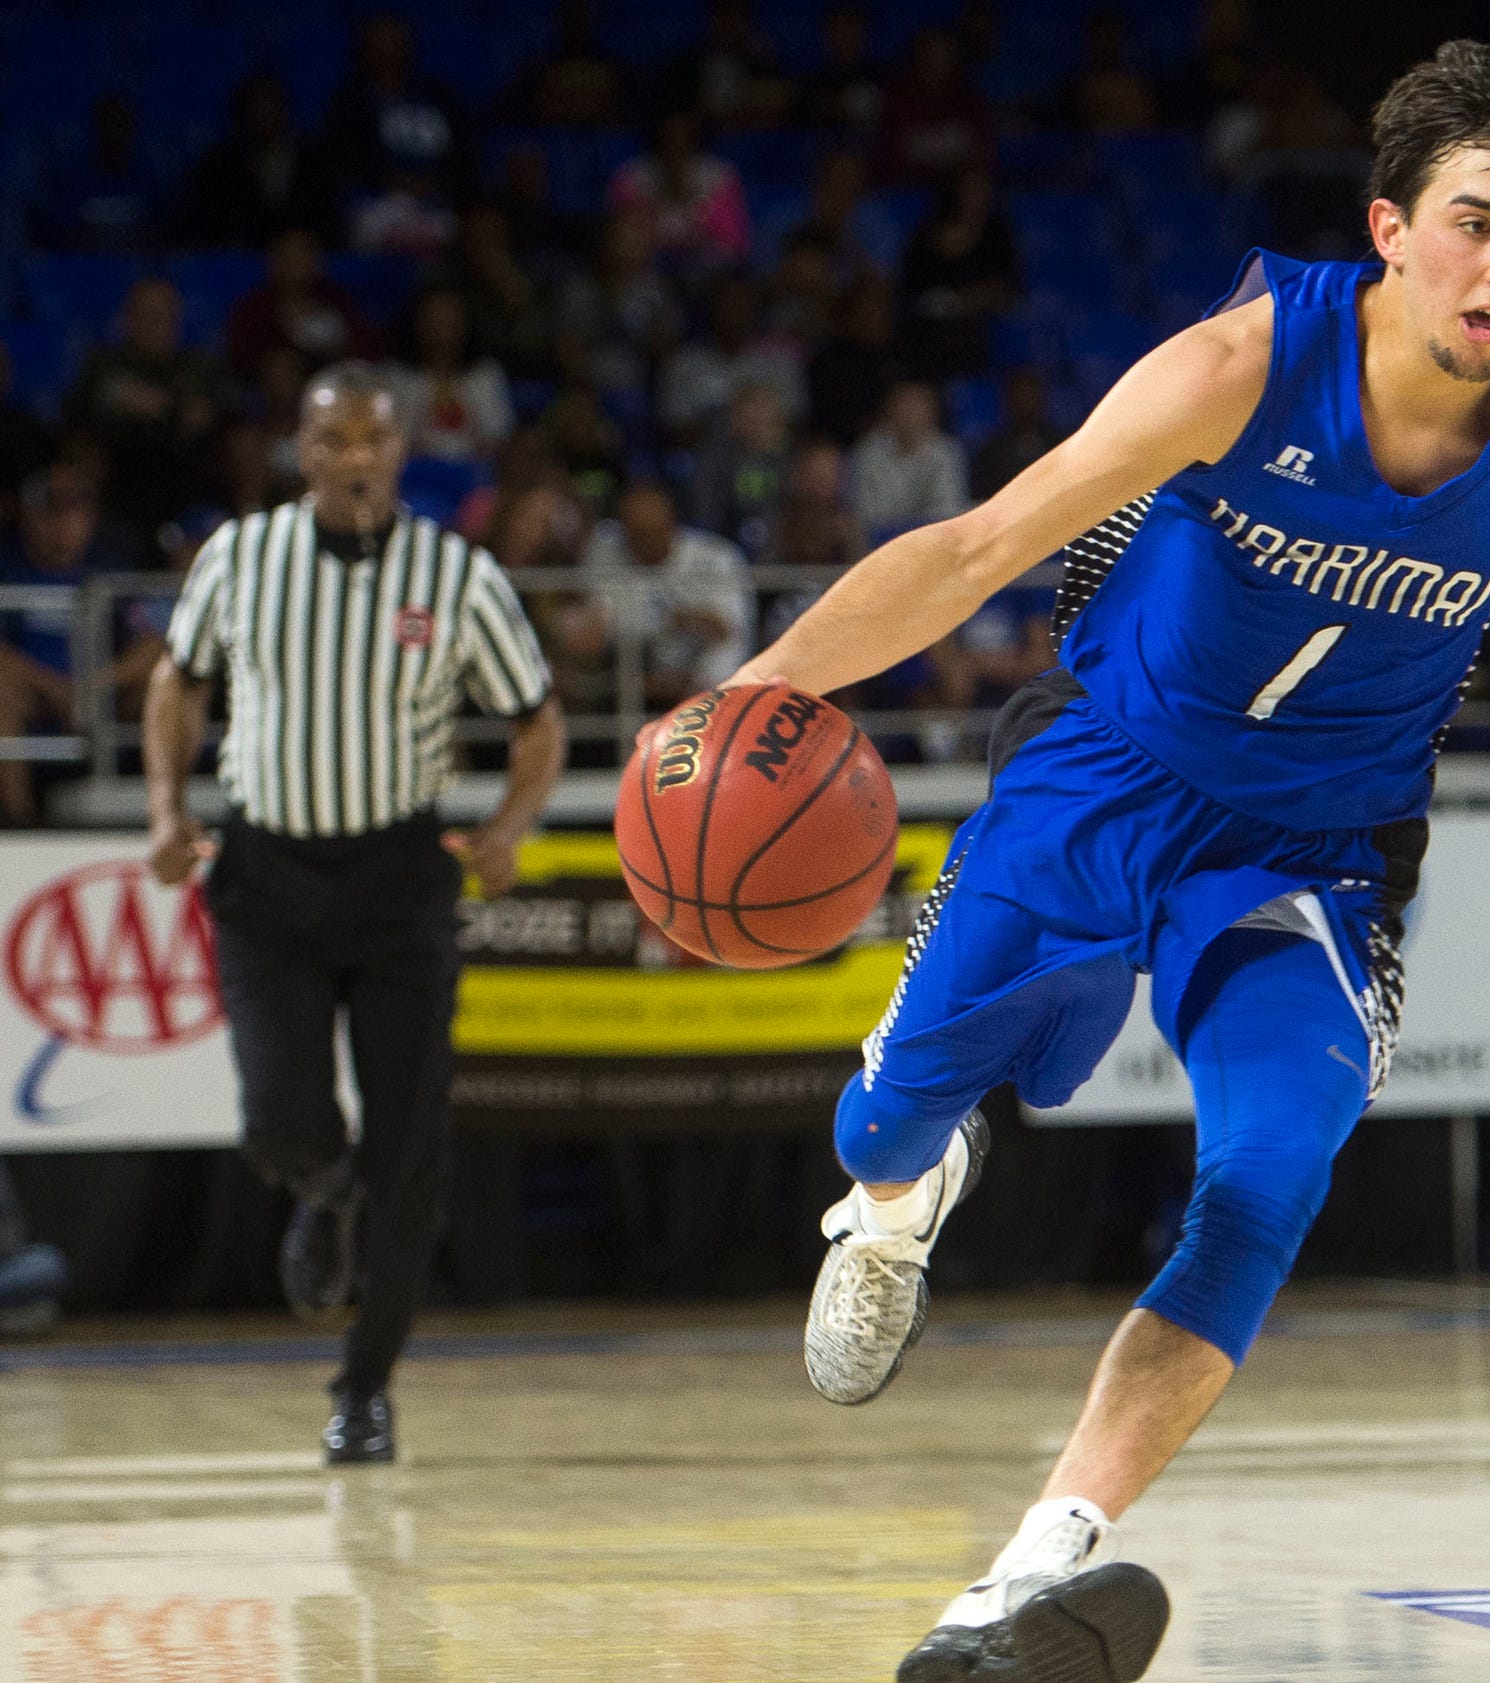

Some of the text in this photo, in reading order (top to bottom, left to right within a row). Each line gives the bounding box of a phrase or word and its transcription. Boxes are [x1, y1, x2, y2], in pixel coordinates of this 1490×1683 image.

[1262, 462, 1317, 487] RUSSELL
[1245, 624, 1346, 721] 1
[744, 692, 827, 783] NCAA
